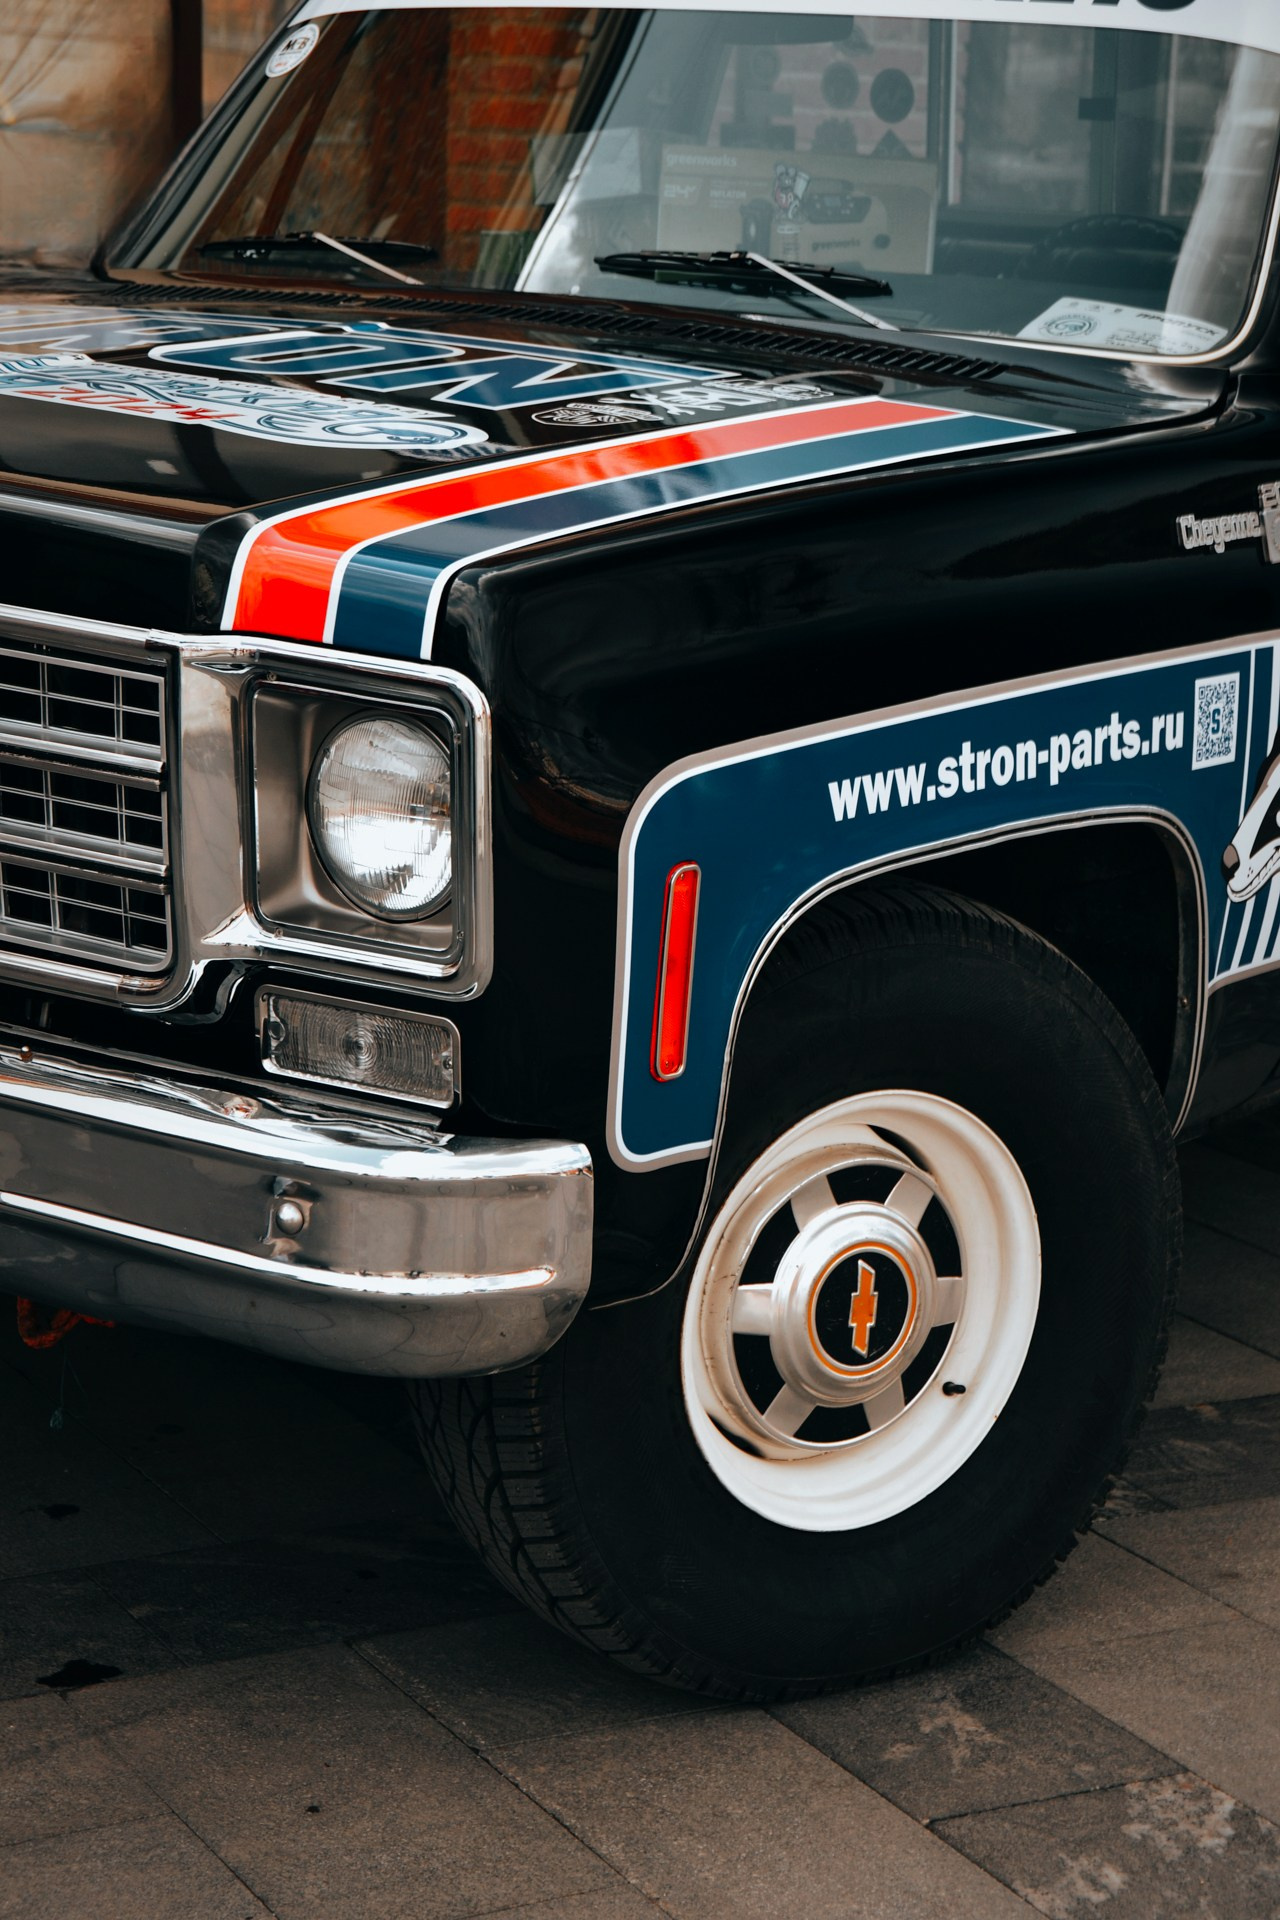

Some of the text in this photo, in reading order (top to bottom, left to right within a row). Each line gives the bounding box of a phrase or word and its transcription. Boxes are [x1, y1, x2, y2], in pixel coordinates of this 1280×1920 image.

[666, 153, 737, 168] greenworks
[17, 386, 245, 420] 2024
[1178, 511, 1262, 553] Cheyenne
[1211, 708, 1221, 735] S
[828, 711, 1185, 822] www.stron-parts.ru
